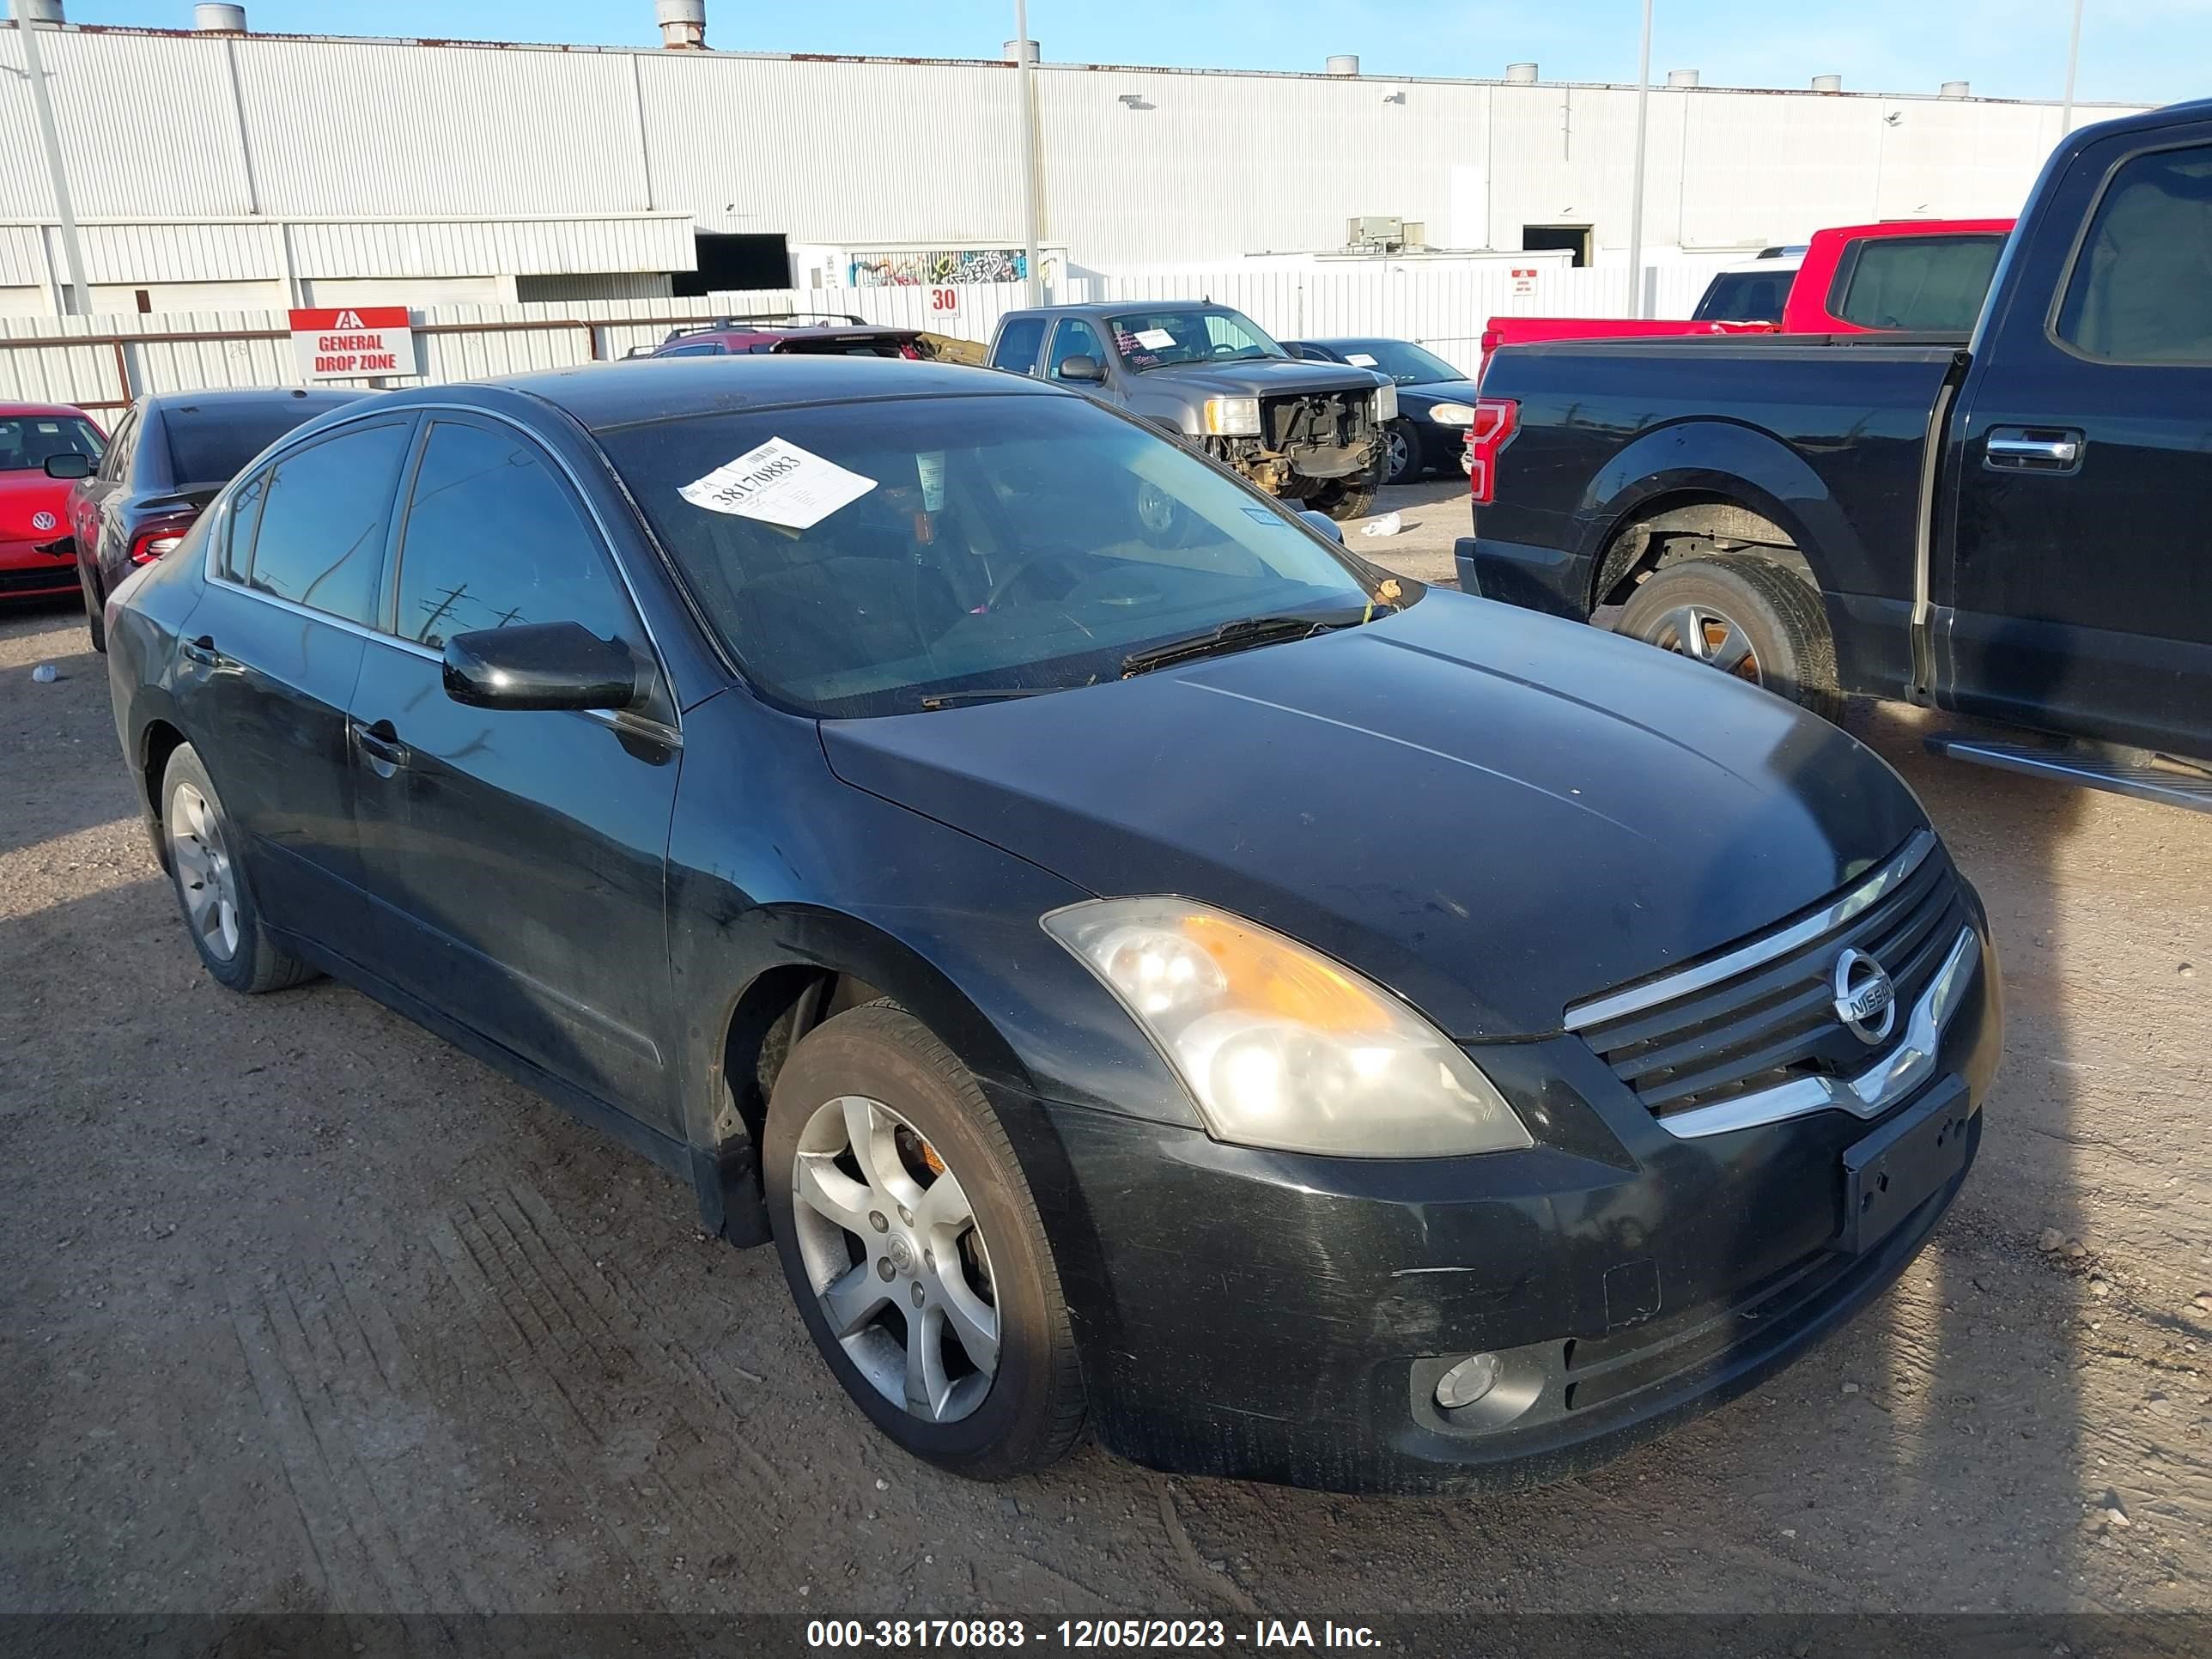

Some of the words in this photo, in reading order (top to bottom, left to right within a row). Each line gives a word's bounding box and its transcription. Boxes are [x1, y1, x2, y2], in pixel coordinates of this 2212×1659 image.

[933, 289, 955, 310] 30
[319, 335, 384, 352] GENERAL
[315, 356, 356, 372] DROP
[359, 354, 397, 370] ZONE
[712, 456, 801, 505] 38170883
